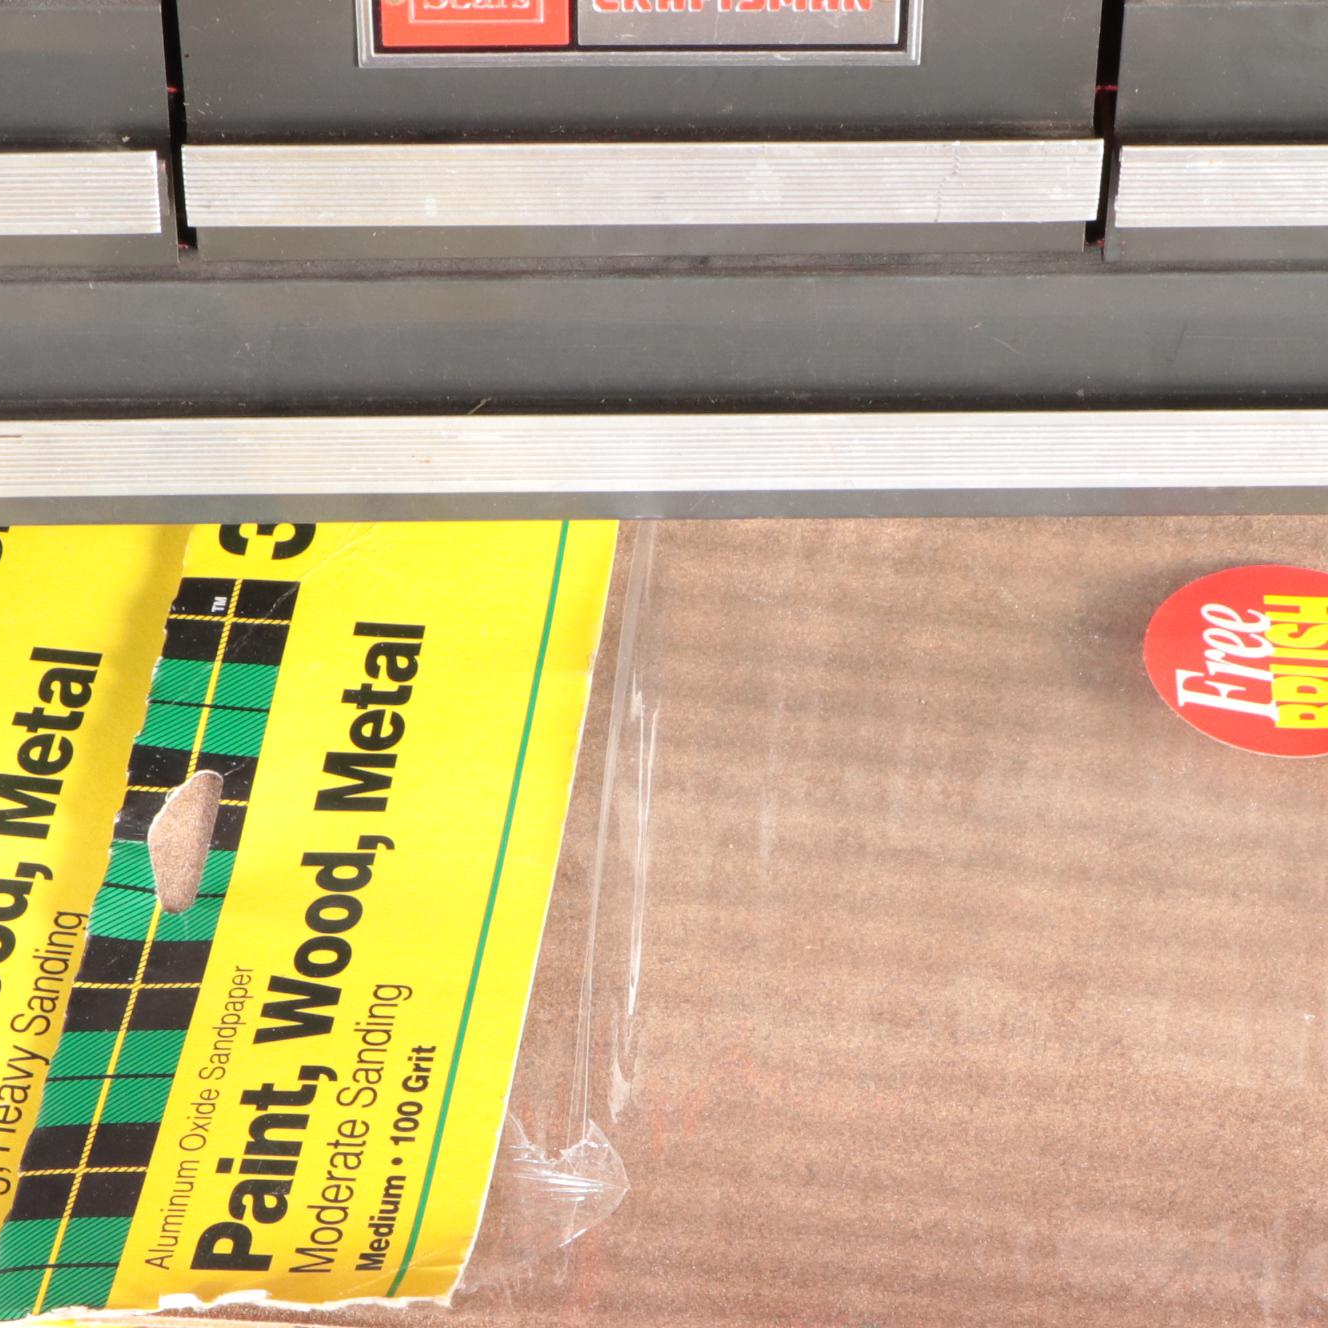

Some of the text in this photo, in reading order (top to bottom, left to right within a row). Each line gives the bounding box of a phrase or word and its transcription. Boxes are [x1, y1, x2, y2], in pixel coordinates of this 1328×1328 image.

[211, 596, 228, 613] TM
[1175, 603, 1279, 722] Free
[10, 910, 90, 1036] Sanding
[190, 621, 426, 1272] Paint, Wood, Metal
[144, 965, 254, 1271] Aluminum Oxide Sandpaper
[288, 983, 414, 1274] Moderate Sanding
[355, 1045, 438, 1272] Medium 100 Grit
